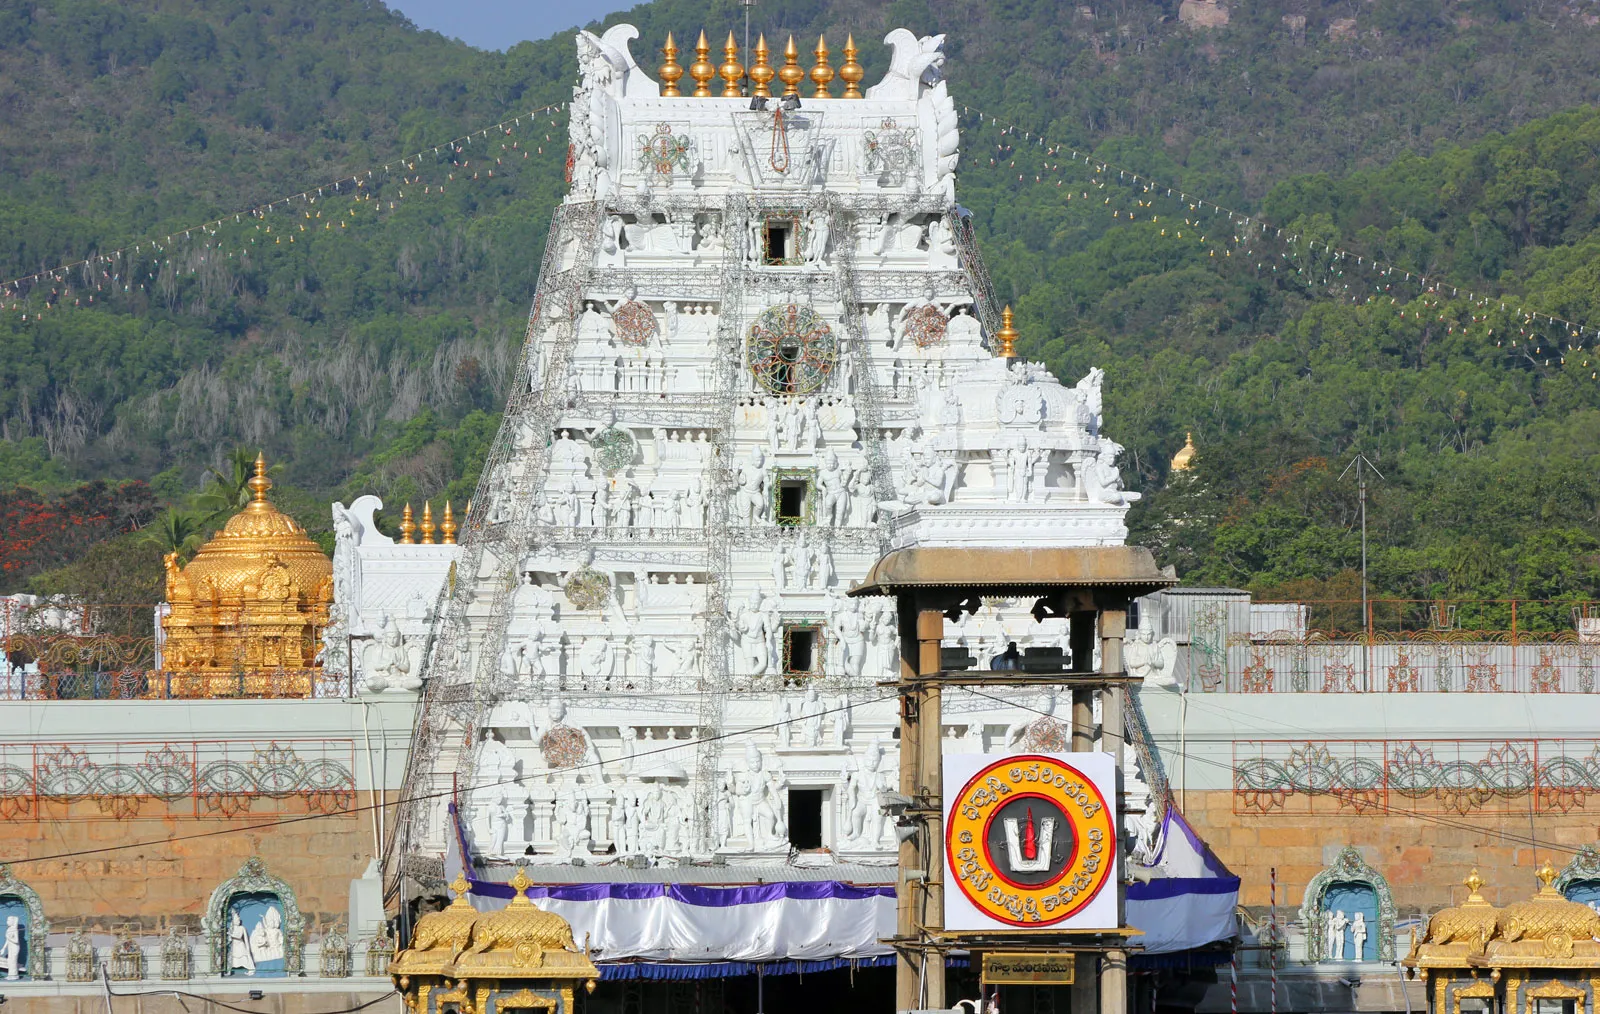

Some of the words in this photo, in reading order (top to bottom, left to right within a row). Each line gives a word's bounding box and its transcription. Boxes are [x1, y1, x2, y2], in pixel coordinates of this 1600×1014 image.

[962, 775, 1012, 820] ధర్మాన్ని
[1008, 764, 1102, 818] ఆచరించండి
[958, 829, 973, 844] ఆ
[957, 847, 993, 892] ధర్మమే
[1041, 828, 1103, 912] కాపాడుతుంది
[987, 885, 1041, 922] మిమ్మల్ని
